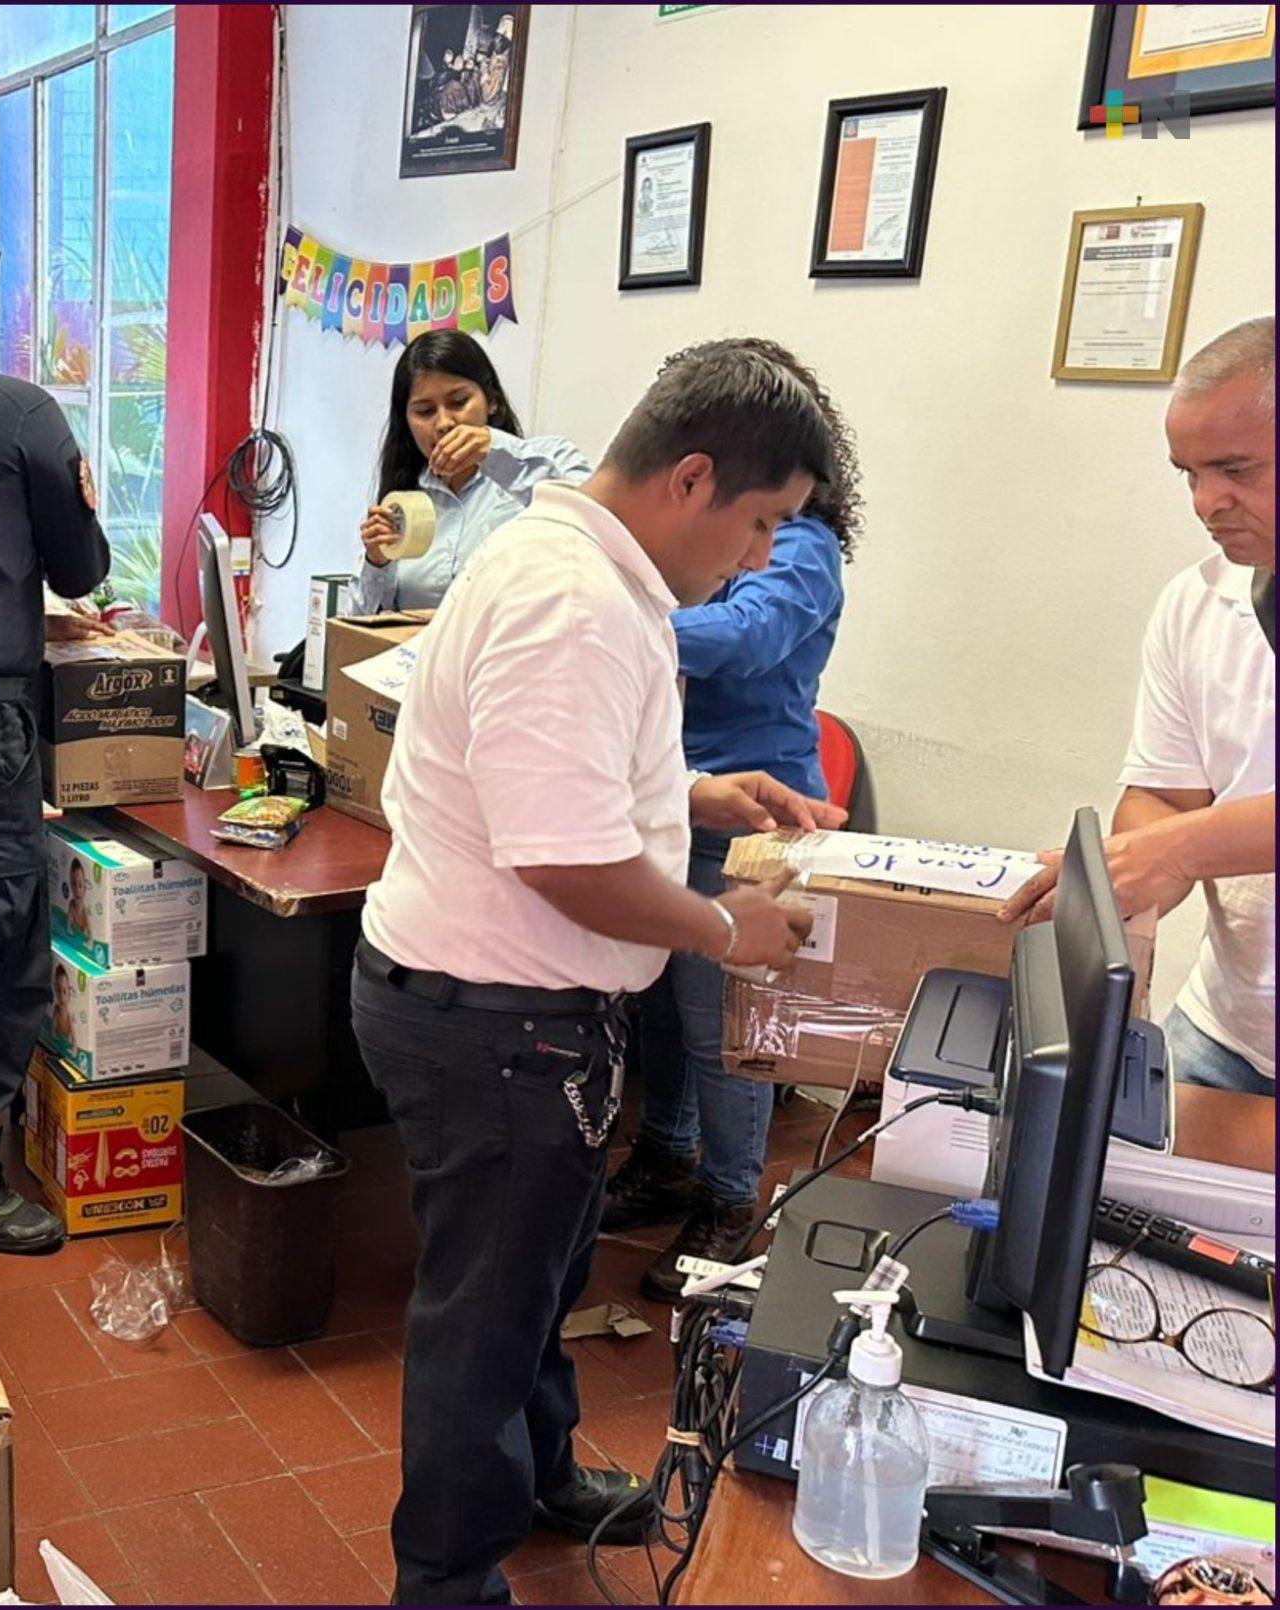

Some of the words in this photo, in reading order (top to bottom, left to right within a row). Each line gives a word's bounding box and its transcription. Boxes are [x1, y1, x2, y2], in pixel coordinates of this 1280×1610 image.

[282, 243, 510, 324] FELICIDADES
[89, 669, 152, 699] Argox
[72, 781, 100, 792] PIEZAS
[112, 883, 156, 897] Toallitas
[158, 876, 203, 891] húmedas
[95, 991, 138, 1005] Toallitas
[140, 984, 186, 998] húmedas
[150, 1115, 169, 1134] 20
